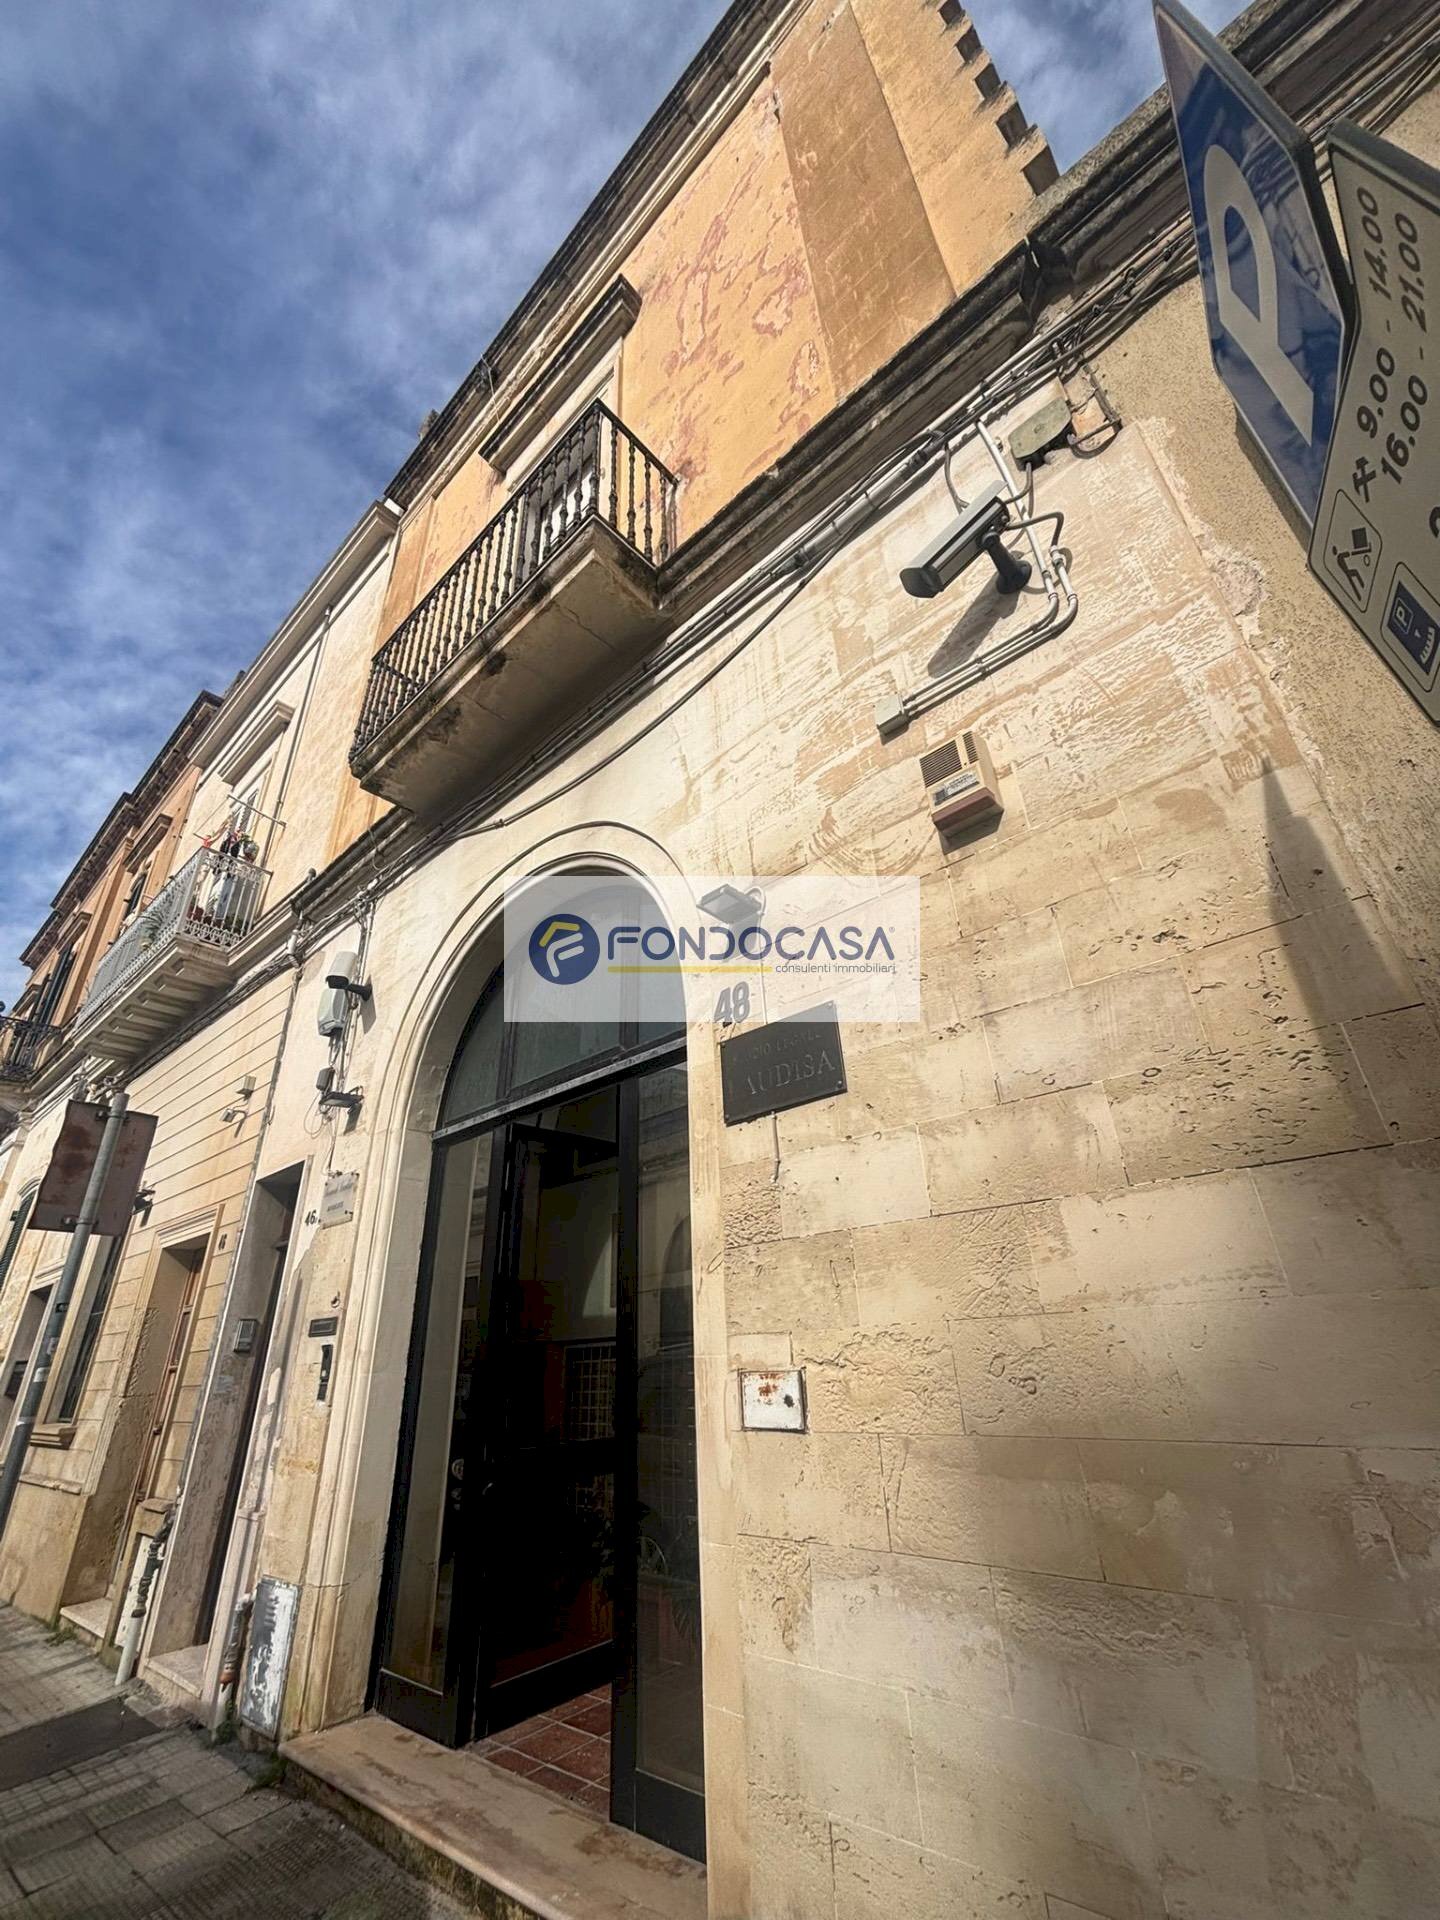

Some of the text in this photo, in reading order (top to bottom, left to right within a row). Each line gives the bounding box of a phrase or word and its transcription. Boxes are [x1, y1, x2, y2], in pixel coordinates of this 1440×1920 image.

[1203, 144, 1314, 447] P
[1356, 186, 1393, 301] 14.00
[1394, 212, 1428, 334] 21.00
[1356, 347, 1395, 439] 9.00
[1381, 374, 1428, 485] 16.00
[713, 981, 750, 1028] 48
